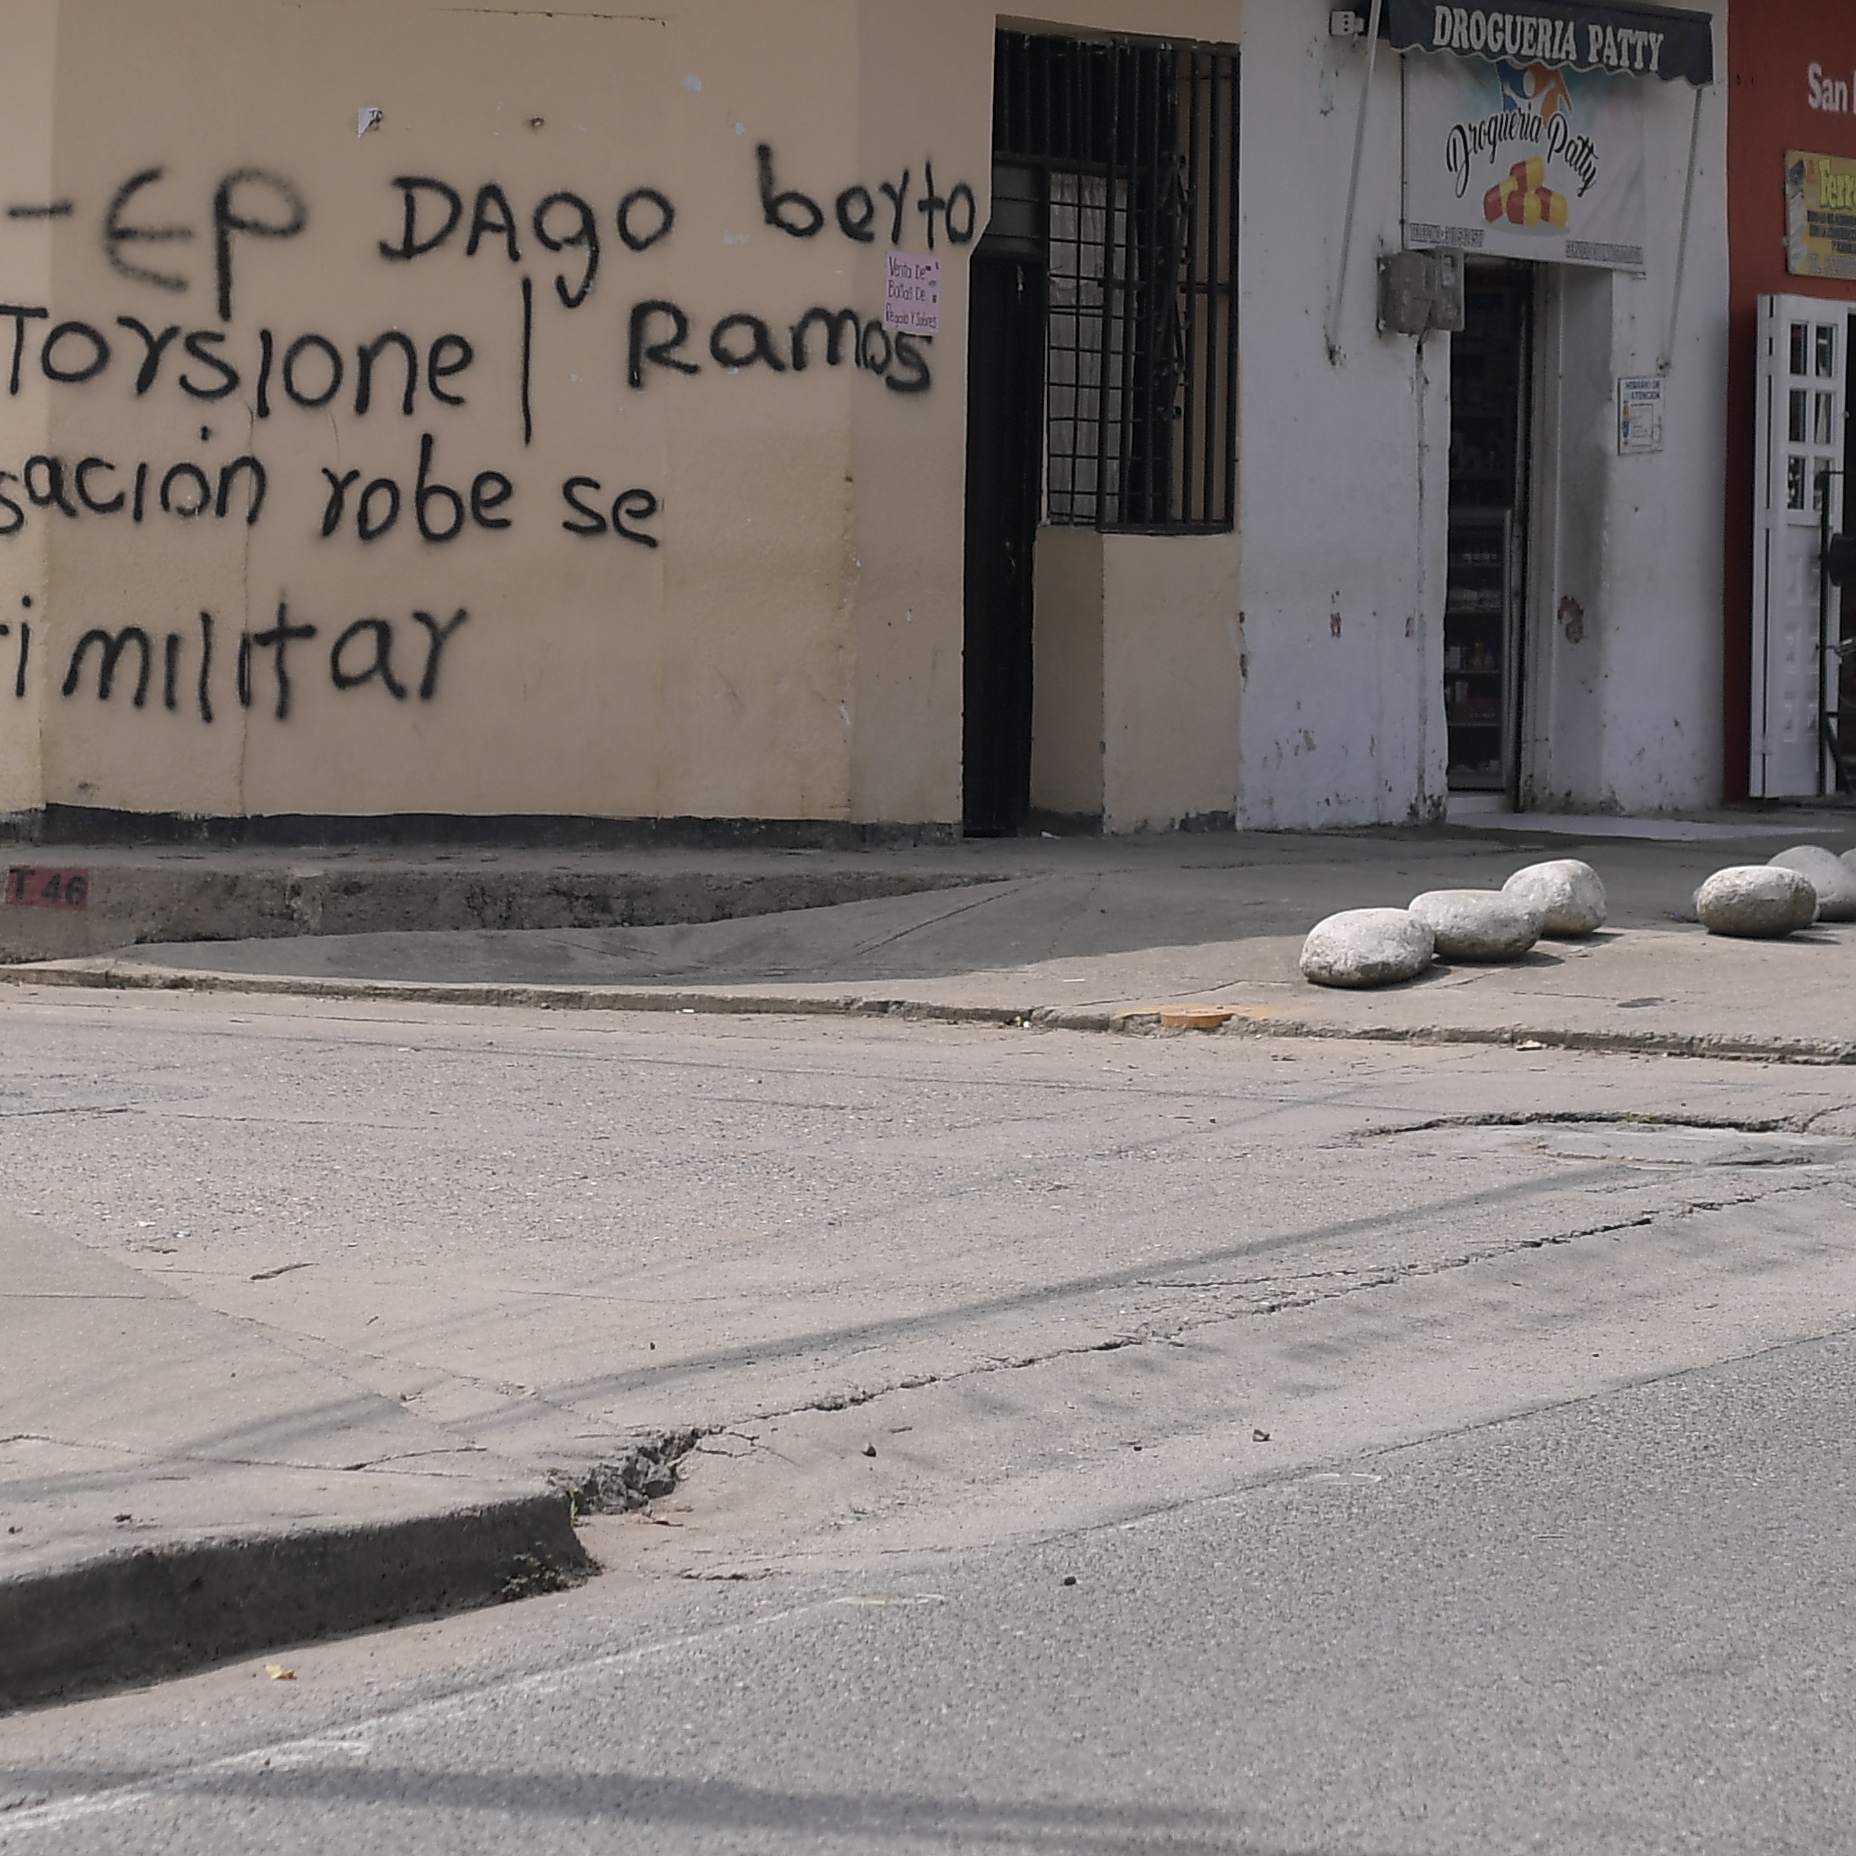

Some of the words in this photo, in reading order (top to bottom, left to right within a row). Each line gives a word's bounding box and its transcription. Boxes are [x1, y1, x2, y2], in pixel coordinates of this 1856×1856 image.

[1433, 5, 1578, 61] DROGUERIA
[1587, 23, 1665, 72] PATTY
[1807, 62, 1848, 113] San
[1445, 101, 1543, 200] Drogueria
[1546, 112, 1600, 199] Patty
[625, 298, 936, 395] Ramos
[318, 431, 516, 546] robe
[560, 475, 661, 550] se
[9, 865, 36, 900] T
[40, 873, 88, 906] 46
